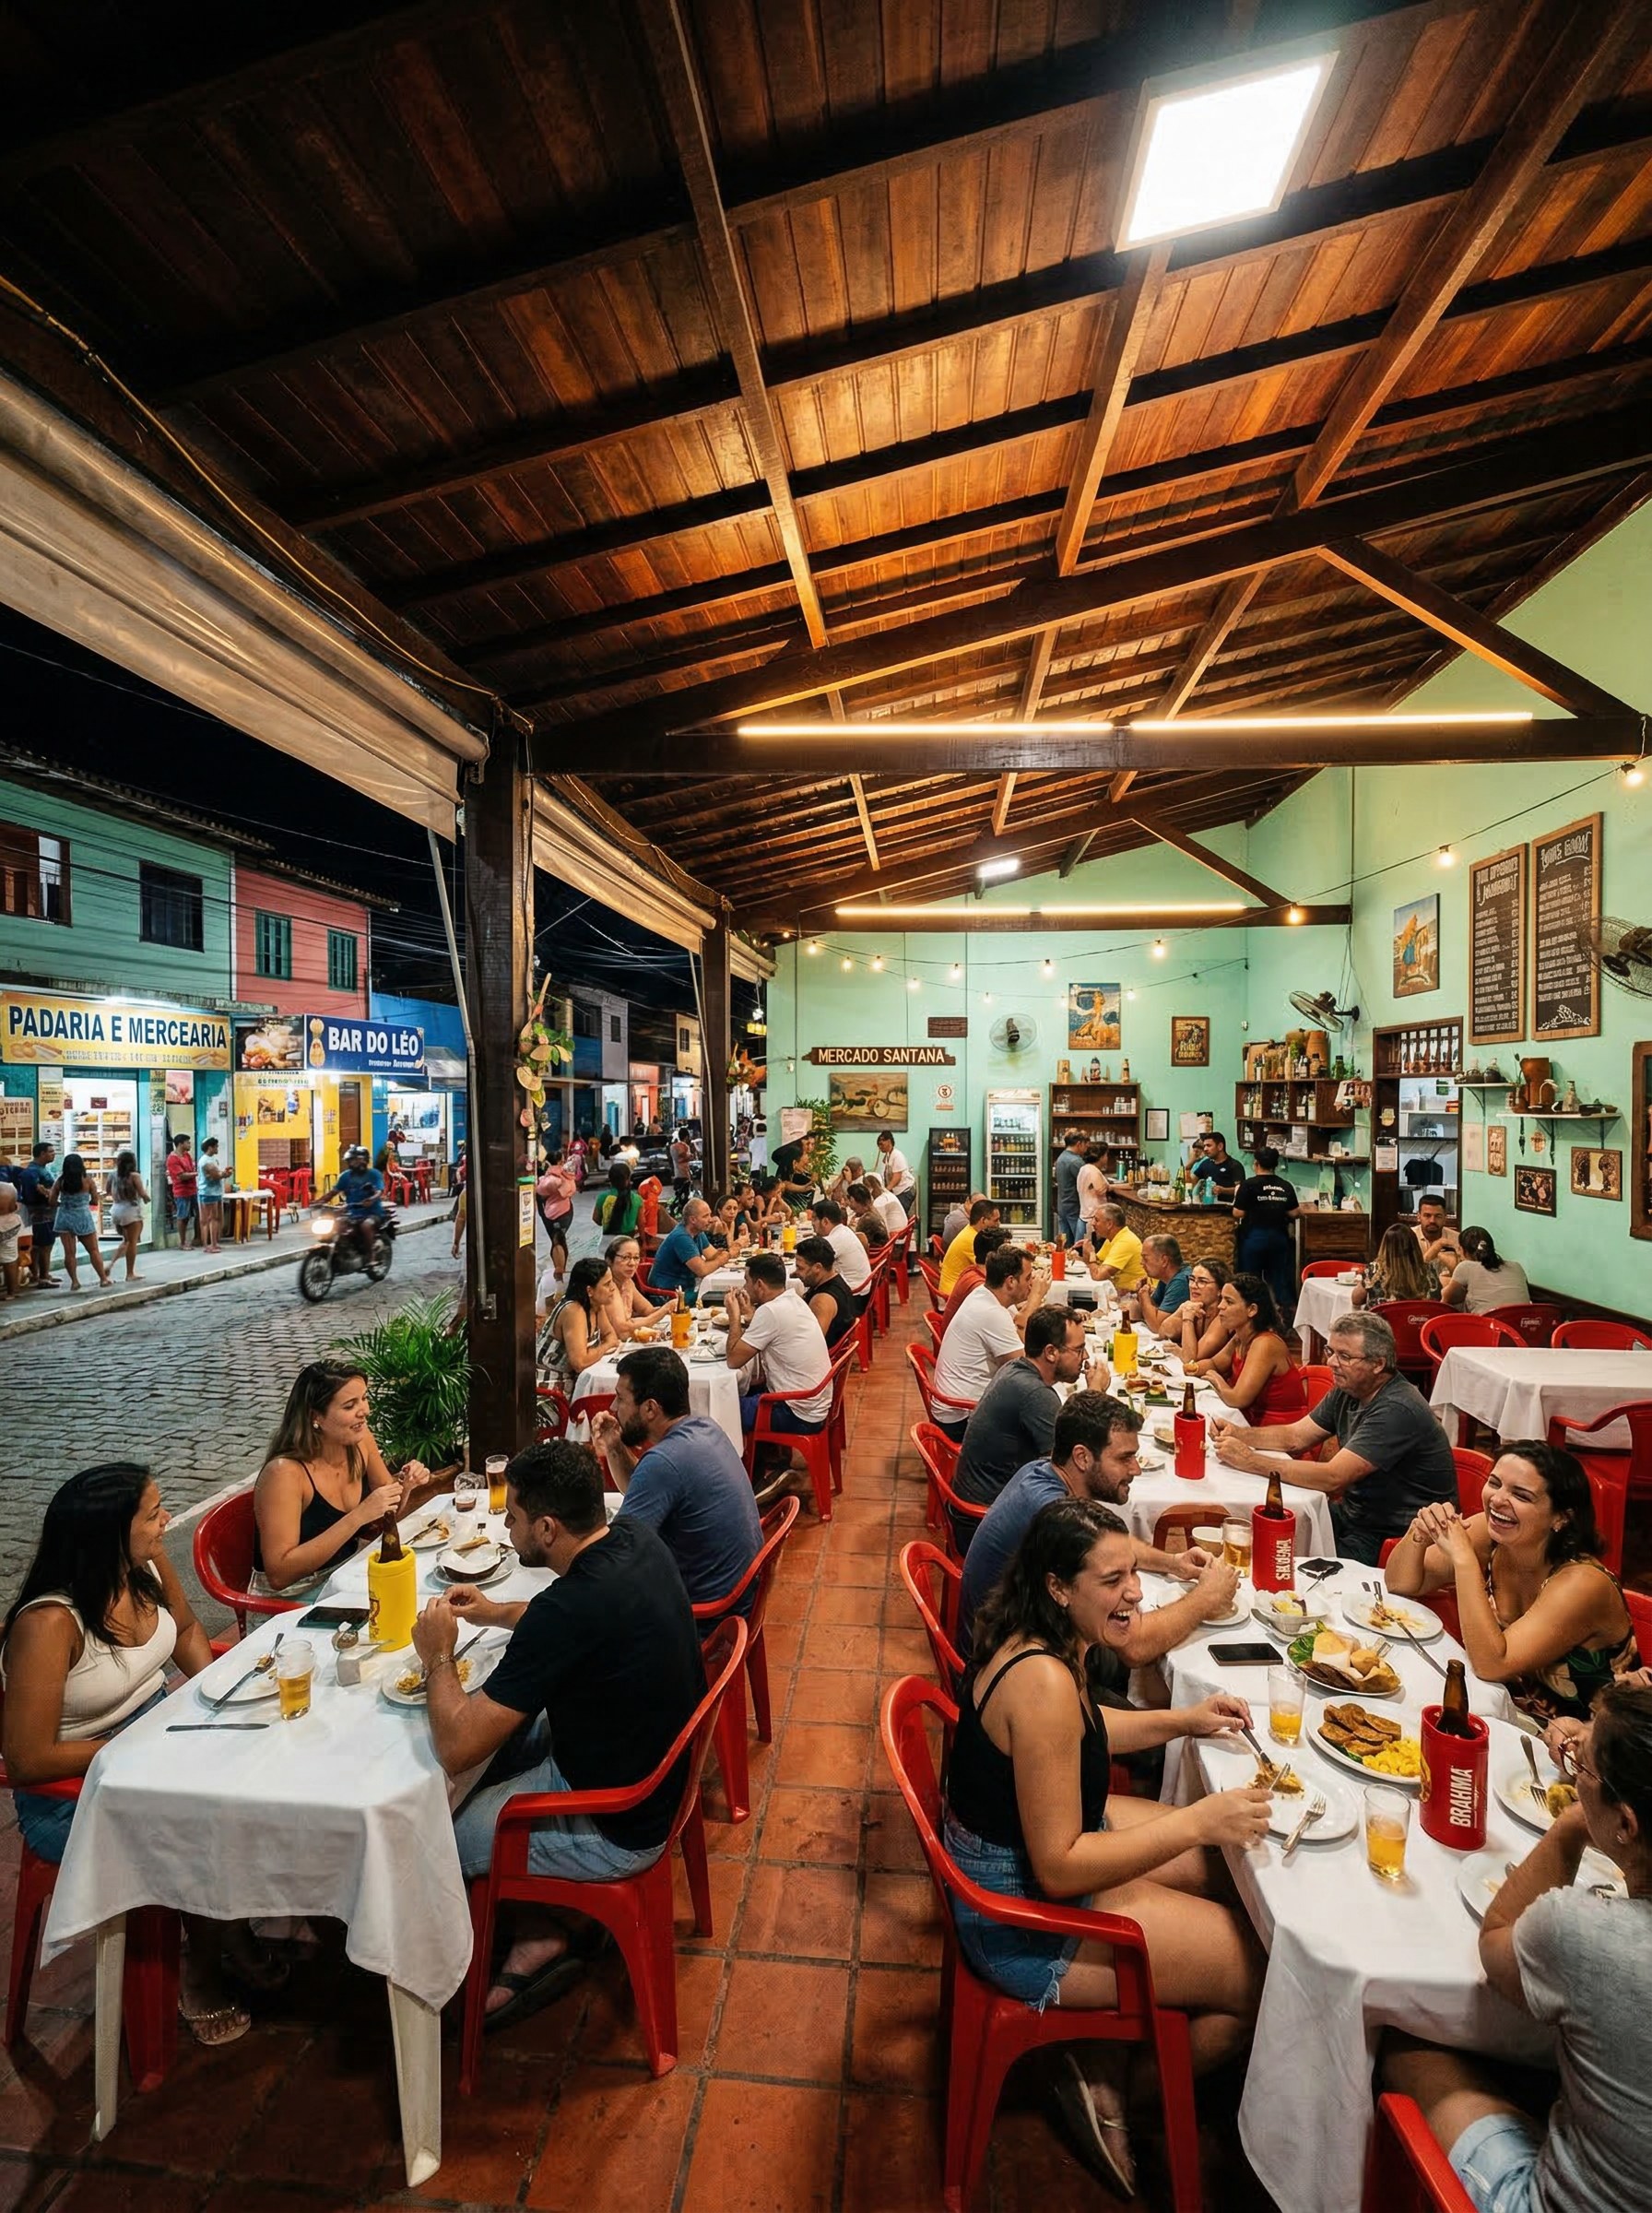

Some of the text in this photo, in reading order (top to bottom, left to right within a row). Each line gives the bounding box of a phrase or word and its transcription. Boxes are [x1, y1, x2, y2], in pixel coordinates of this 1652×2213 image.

[8, 1005, 228, 1049] PADARIA E MERCEARIA
[328, 1026, 419, 1056] BAR DO LÉO
[818, 1048, 945, 1063] MERCADO SANTANA
[1449, 1767, 1474, 1828] BRAHMA
